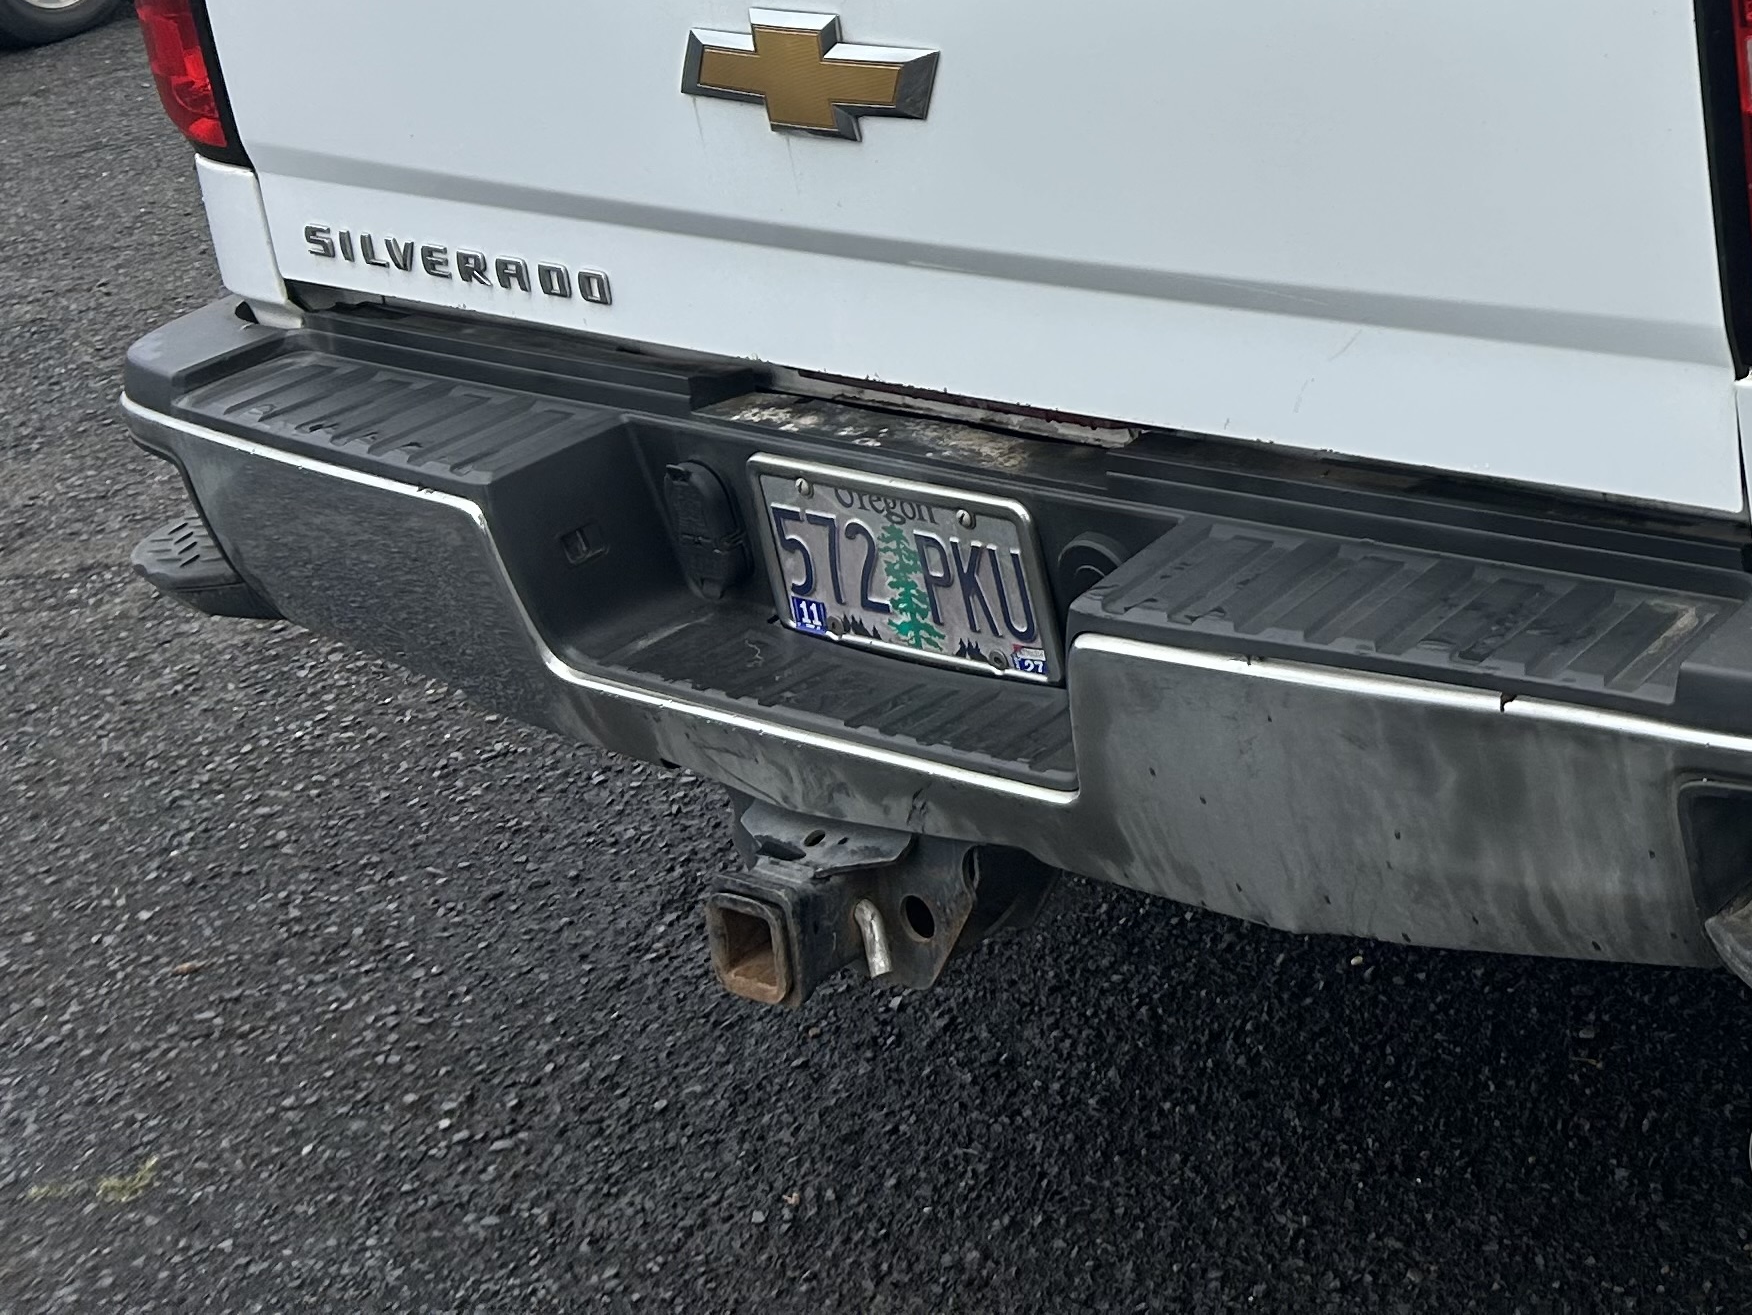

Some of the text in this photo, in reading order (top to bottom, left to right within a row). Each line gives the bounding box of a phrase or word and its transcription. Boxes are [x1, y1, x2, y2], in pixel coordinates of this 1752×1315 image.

[304, 223, 613, 306] SILVERADO
[834, 487, 940, 525] Oregon
[771, 502, 1036, 643] 572 PKU
[800, 600, 822, 626] 11
